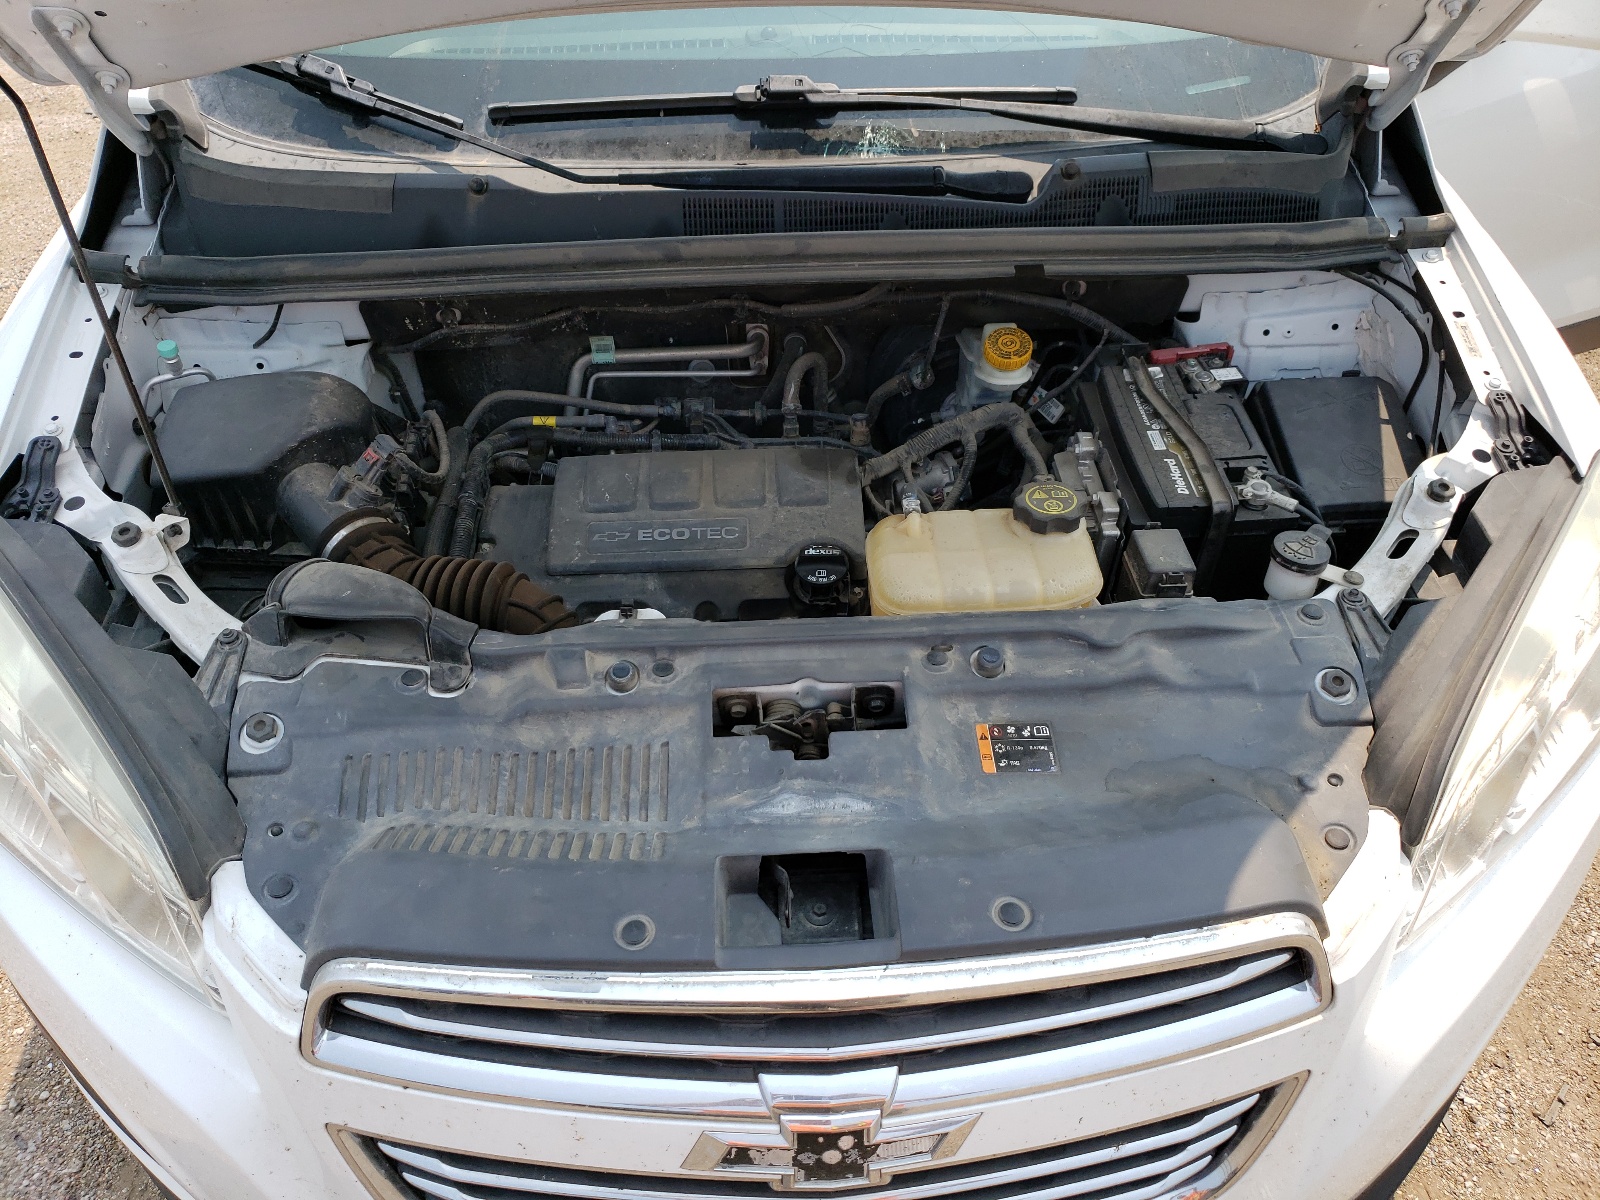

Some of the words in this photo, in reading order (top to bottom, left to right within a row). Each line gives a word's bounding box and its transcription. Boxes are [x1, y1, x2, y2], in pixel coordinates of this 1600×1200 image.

[1163, 458, 1189, 494] DieHard
[637, 526, 740, 542] ECOTEC
[804, 547, 841, 555] dexos
